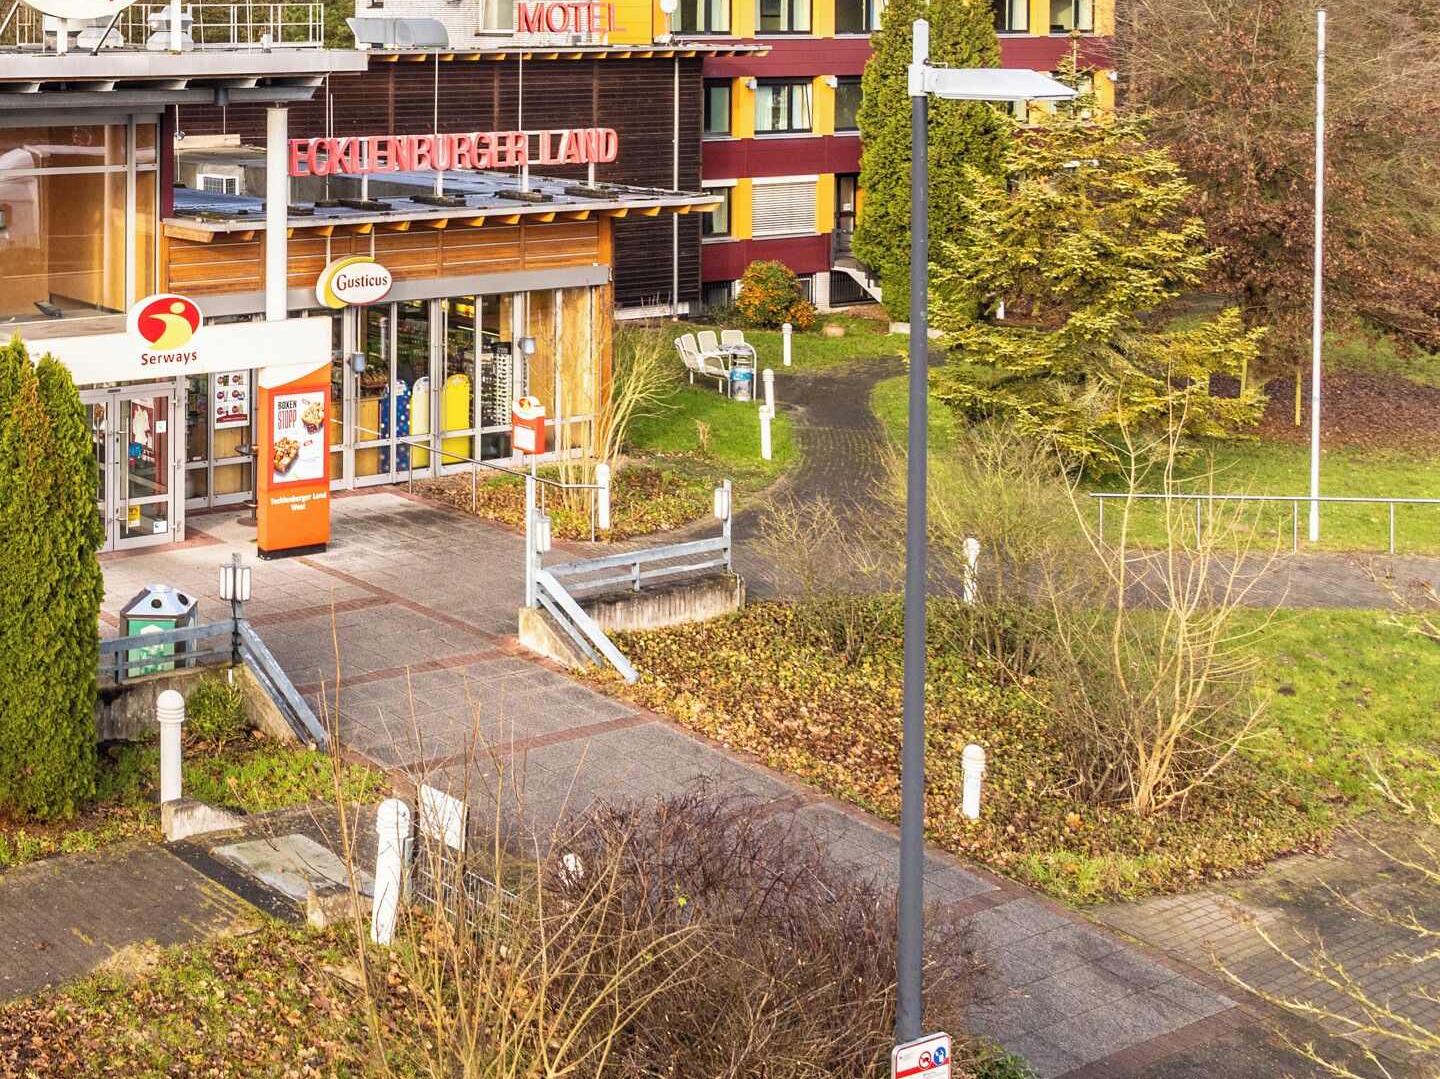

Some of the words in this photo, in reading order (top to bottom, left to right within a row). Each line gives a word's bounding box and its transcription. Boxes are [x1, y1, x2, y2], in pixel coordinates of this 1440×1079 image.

[517, 2, 627, 33] MOTEL
[288, 129, 529, 177] ECKLENBURGER
[539, 127, 618, 166] LAND
[336, 274, 388, 291] Gusticus
[141, 351, 197, 366] Serways
[277, 400, 297, 410] BOXEN
[277, 409, 297, 430] STOPP
[270, 494, 312, 505] Tecklenburger
